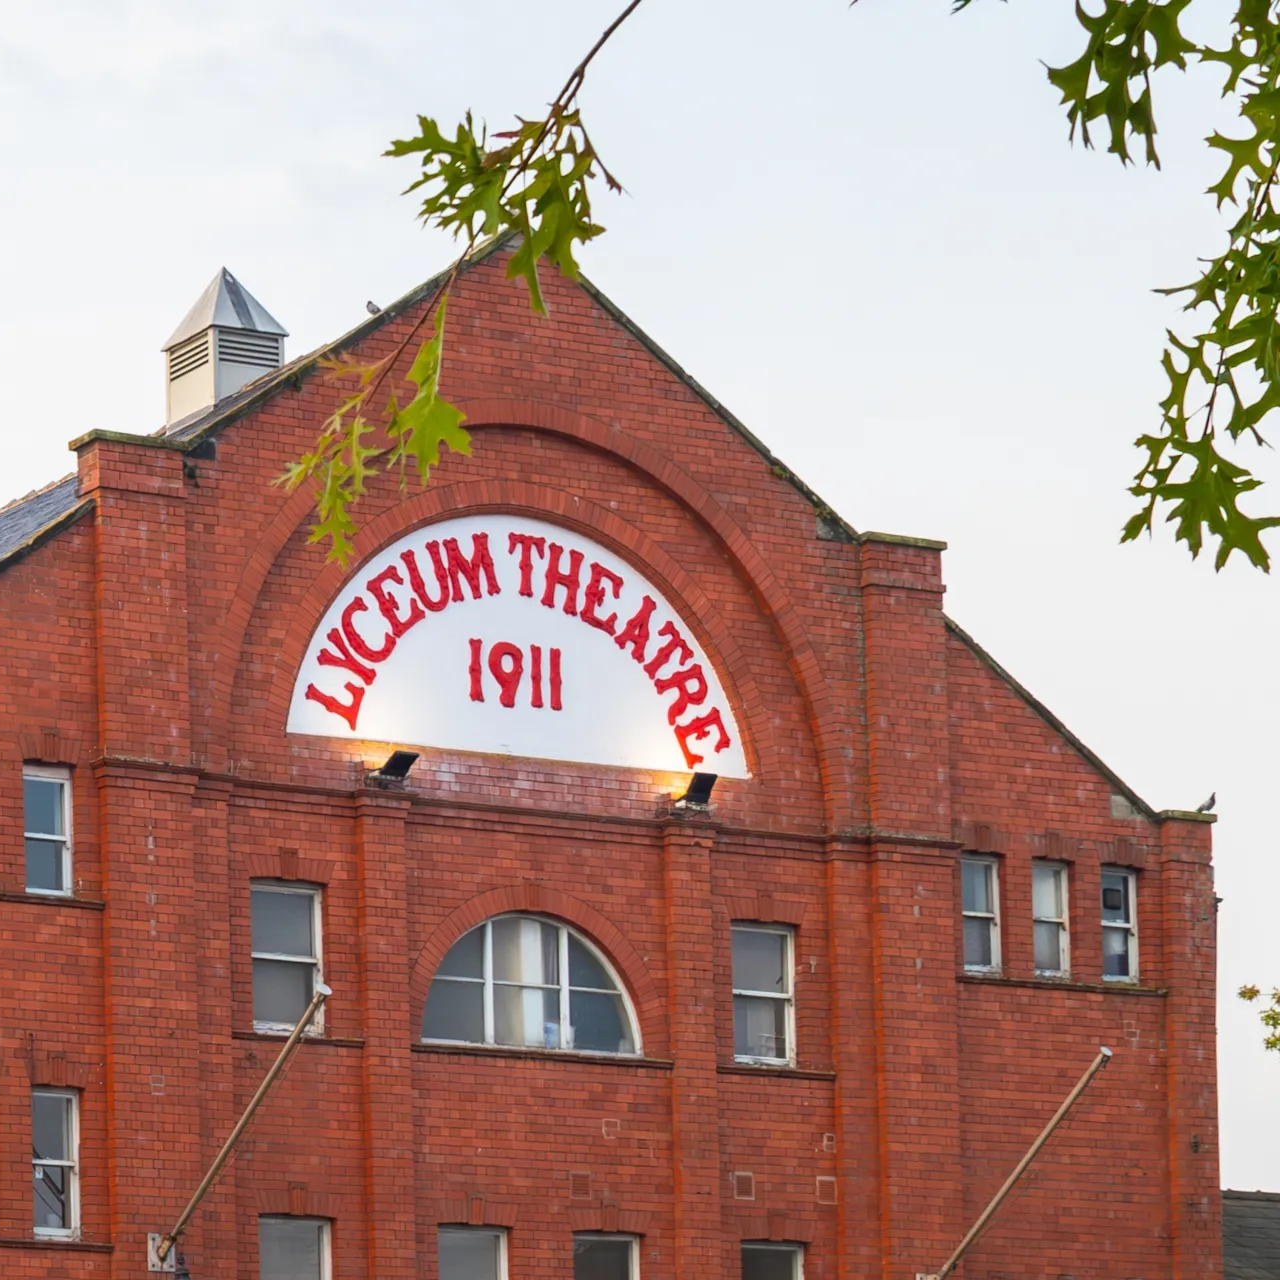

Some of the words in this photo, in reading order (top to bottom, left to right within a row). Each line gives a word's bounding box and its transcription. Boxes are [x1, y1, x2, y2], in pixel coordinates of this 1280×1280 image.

[305, 532, 501, 731] LYCEUM
[508, 532, 732, 770] THEATRE
[468, 637, 563, 711] 1911
